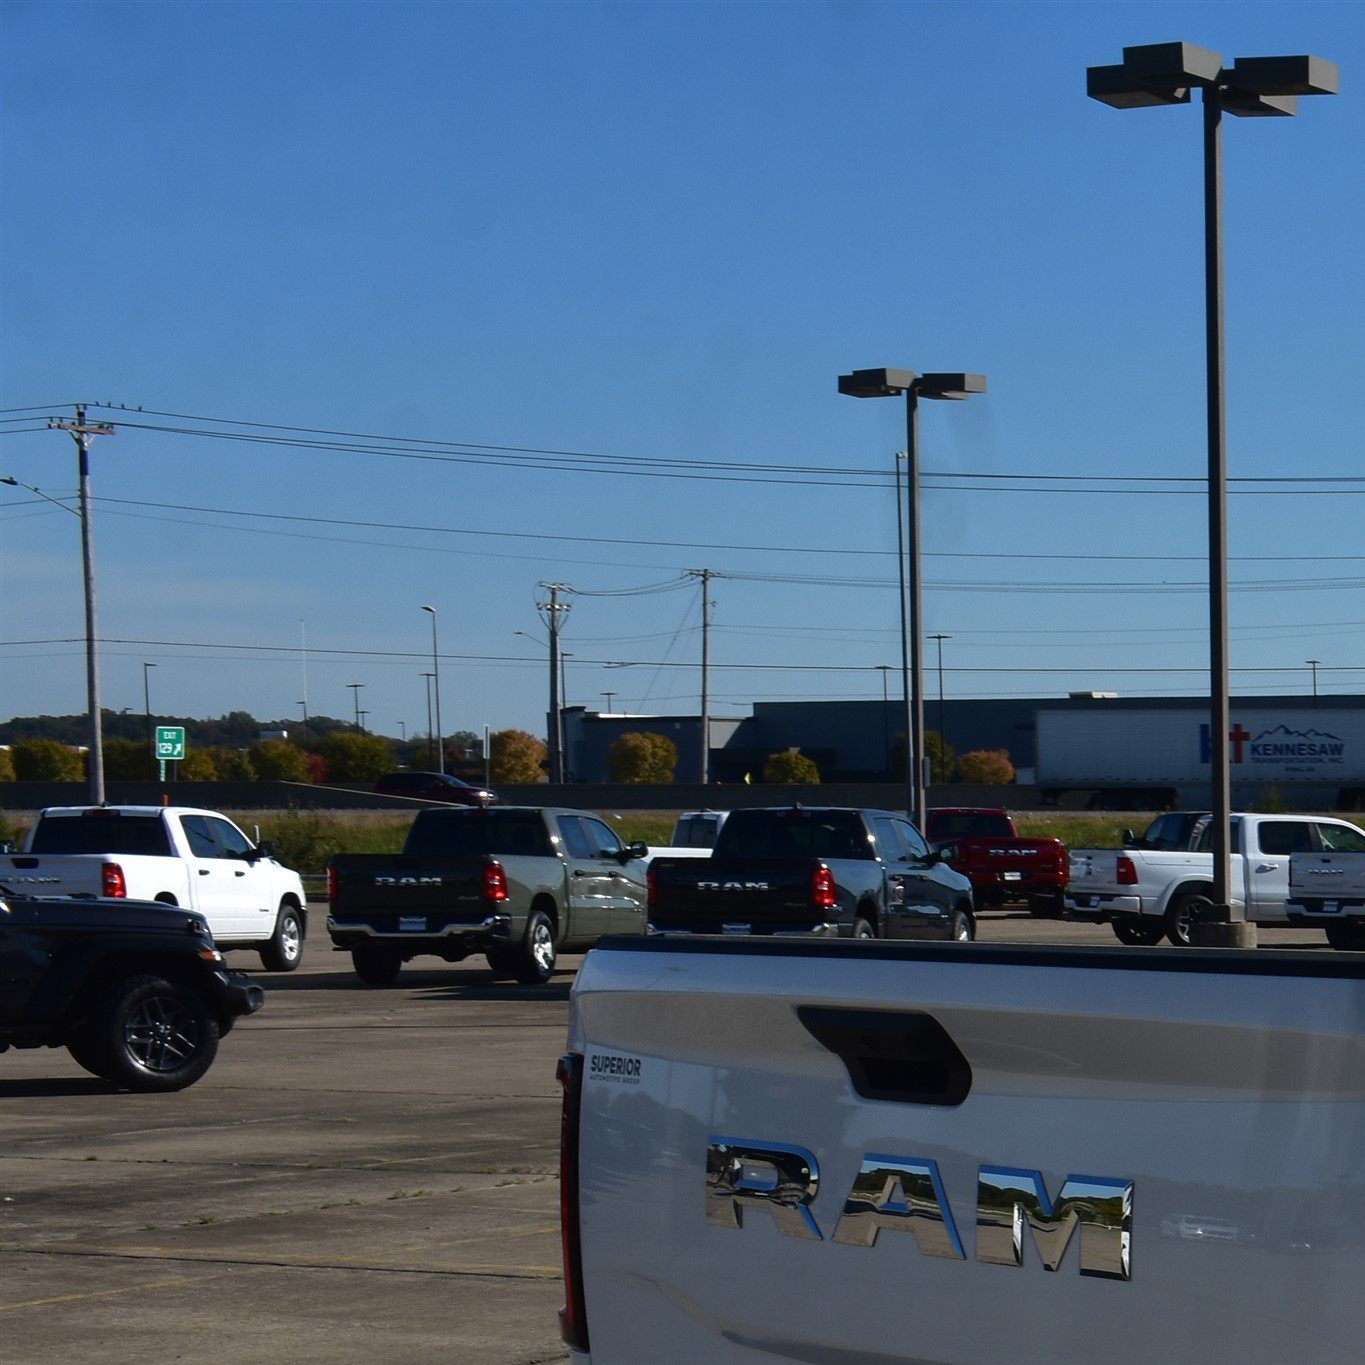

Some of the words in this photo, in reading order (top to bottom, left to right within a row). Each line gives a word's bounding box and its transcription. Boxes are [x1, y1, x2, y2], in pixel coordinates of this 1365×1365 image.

[1250, 743, 1344, 756] KENNESAW
[373, 876, 442, 886] RAM
[696, 881, 769, 890] RAM
[590, 1054, 642, 1077] SUPERIOR
[705, 1135, 1135, 1282] RAM
